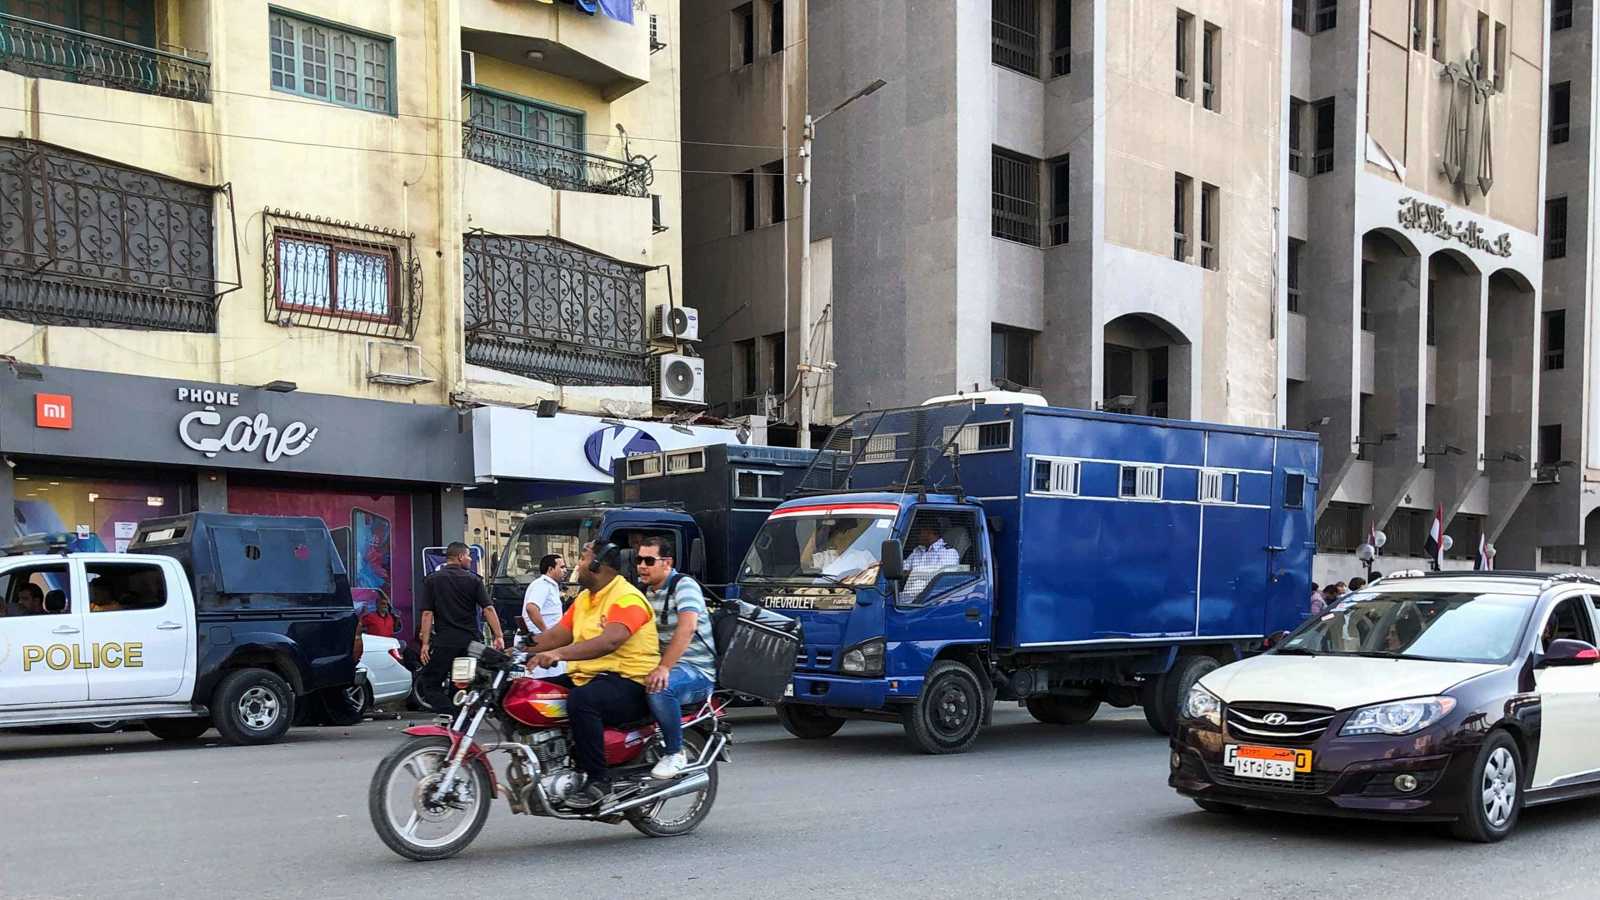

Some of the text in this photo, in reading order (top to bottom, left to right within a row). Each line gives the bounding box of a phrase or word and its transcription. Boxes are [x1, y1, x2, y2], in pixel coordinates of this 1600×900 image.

[178, 387, 240, 406] PHONE
[179, 405, 319, 463] Care
[764, 595, 817, 609] CHEVROLET
[22, 641, 144, 672] POLICE
